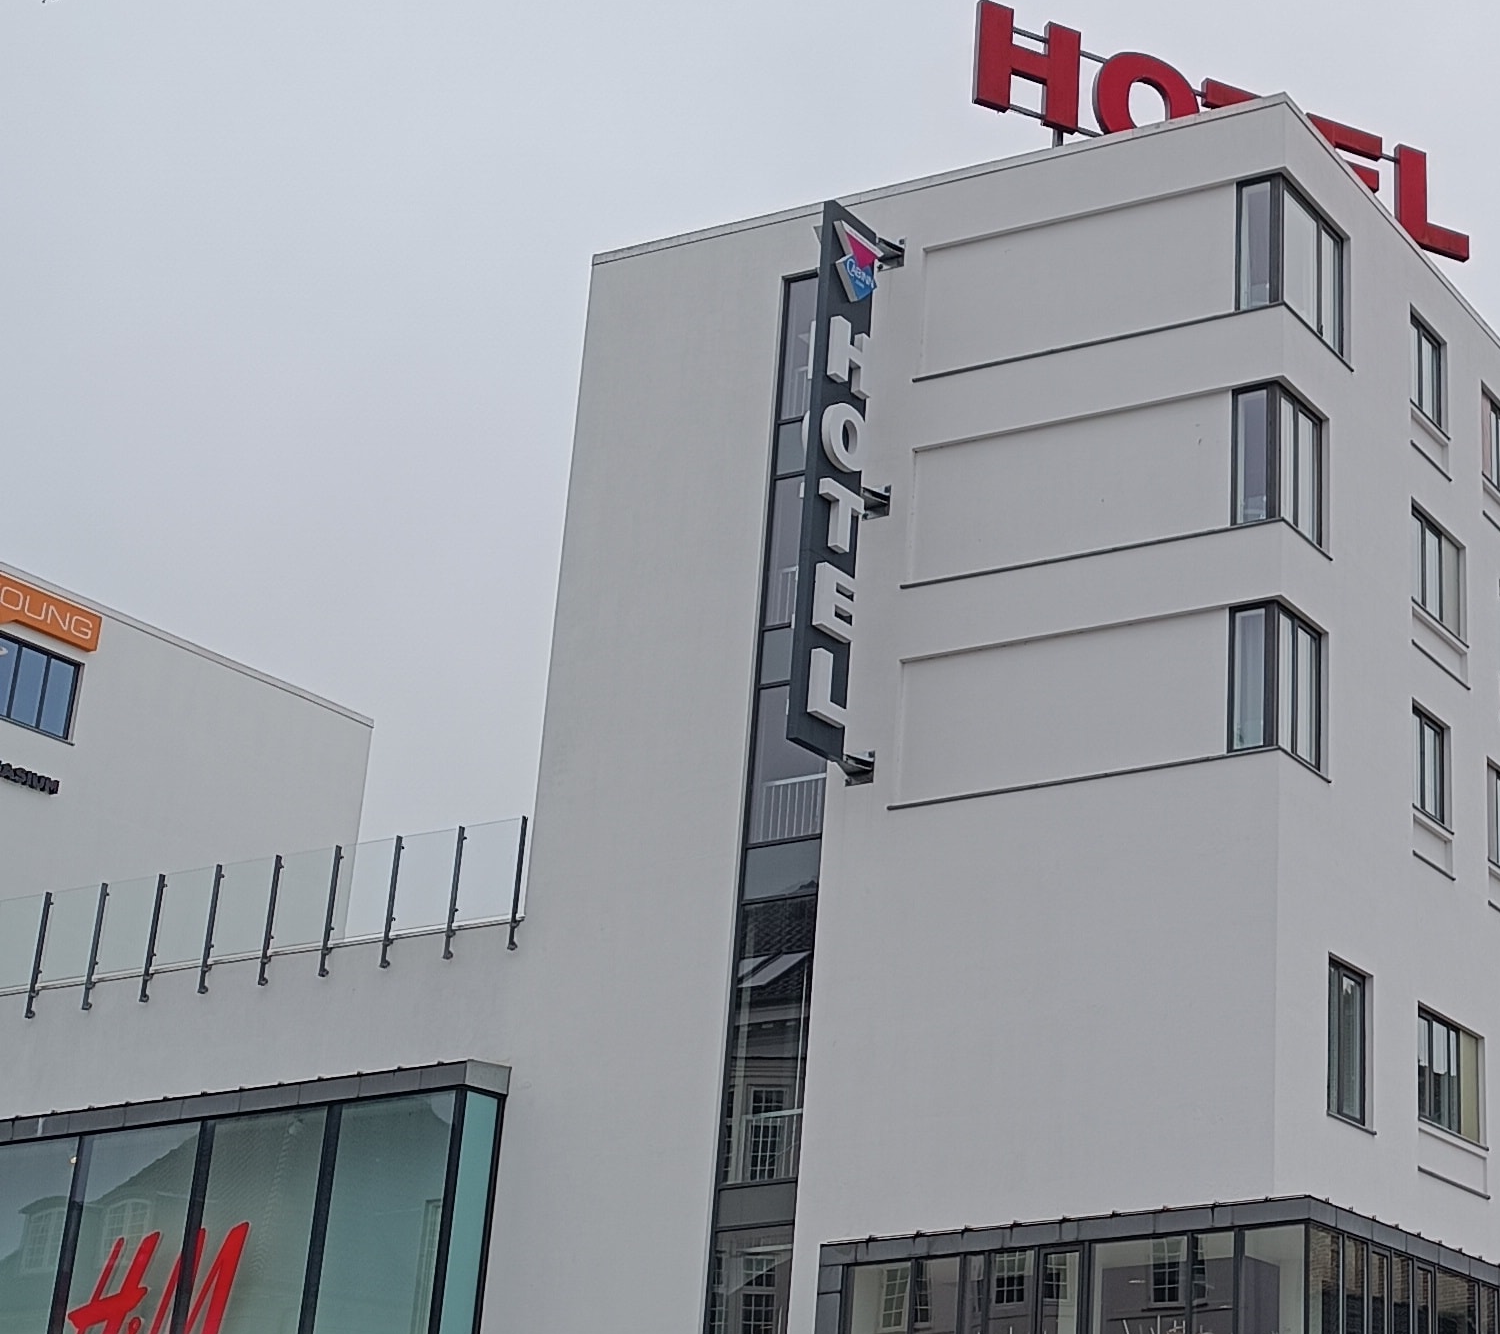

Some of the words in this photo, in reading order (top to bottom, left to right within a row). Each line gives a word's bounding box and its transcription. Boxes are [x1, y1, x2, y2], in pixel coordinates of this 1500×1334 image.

[807, 315, 870, 728] HOTEL
[0, 583, 93, 640] OUNG
[0, 760, 60, 796] ASIUM
